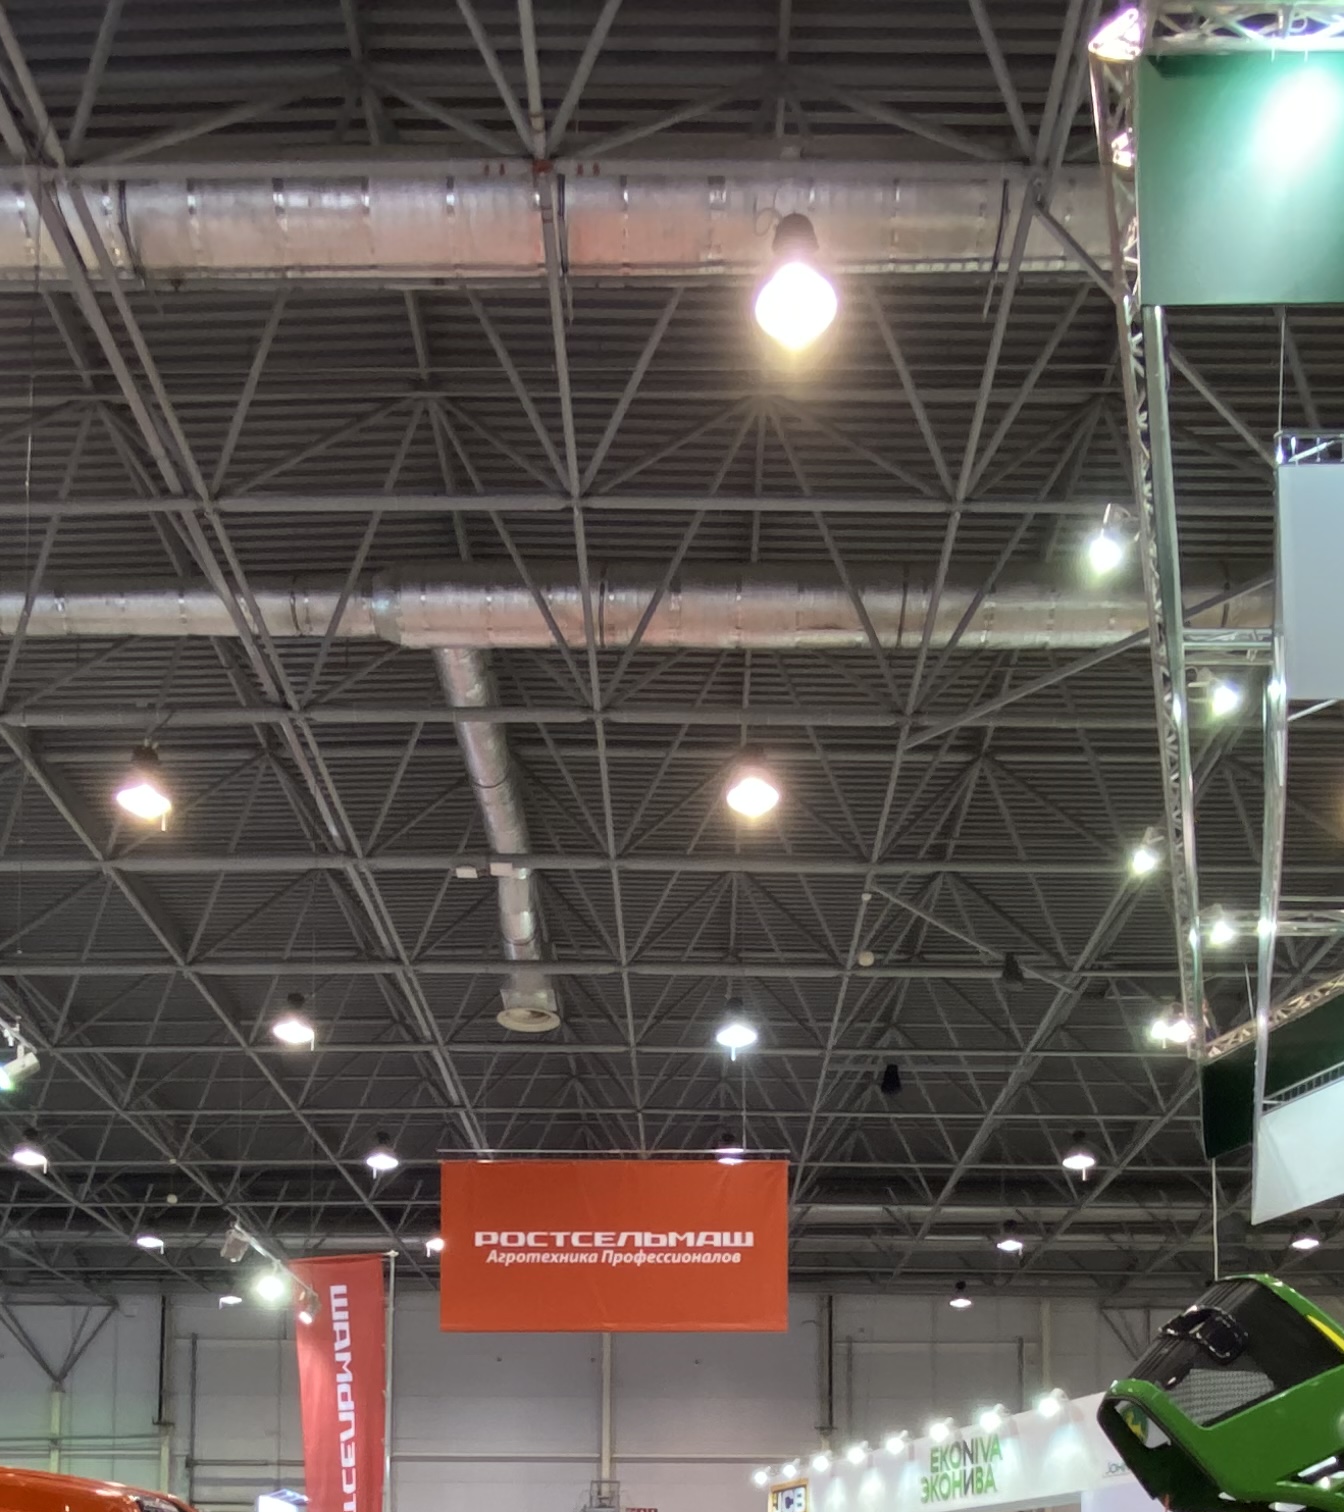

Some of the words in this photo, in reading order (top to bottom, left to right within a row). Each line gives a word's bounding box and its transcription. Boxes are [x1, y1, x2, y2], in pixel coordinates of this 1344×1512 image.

[474, 1231, 754, 1247] РОСТСЕЛЬМАШ
[486, 1250, 598, 1266] Агротехника
[601, 1249, 742, 1267] Профессионалов
[930, 1434, 1003, 1473] EKONIVA
[920, 1464, 998, 1504] ЭКОНИВА
